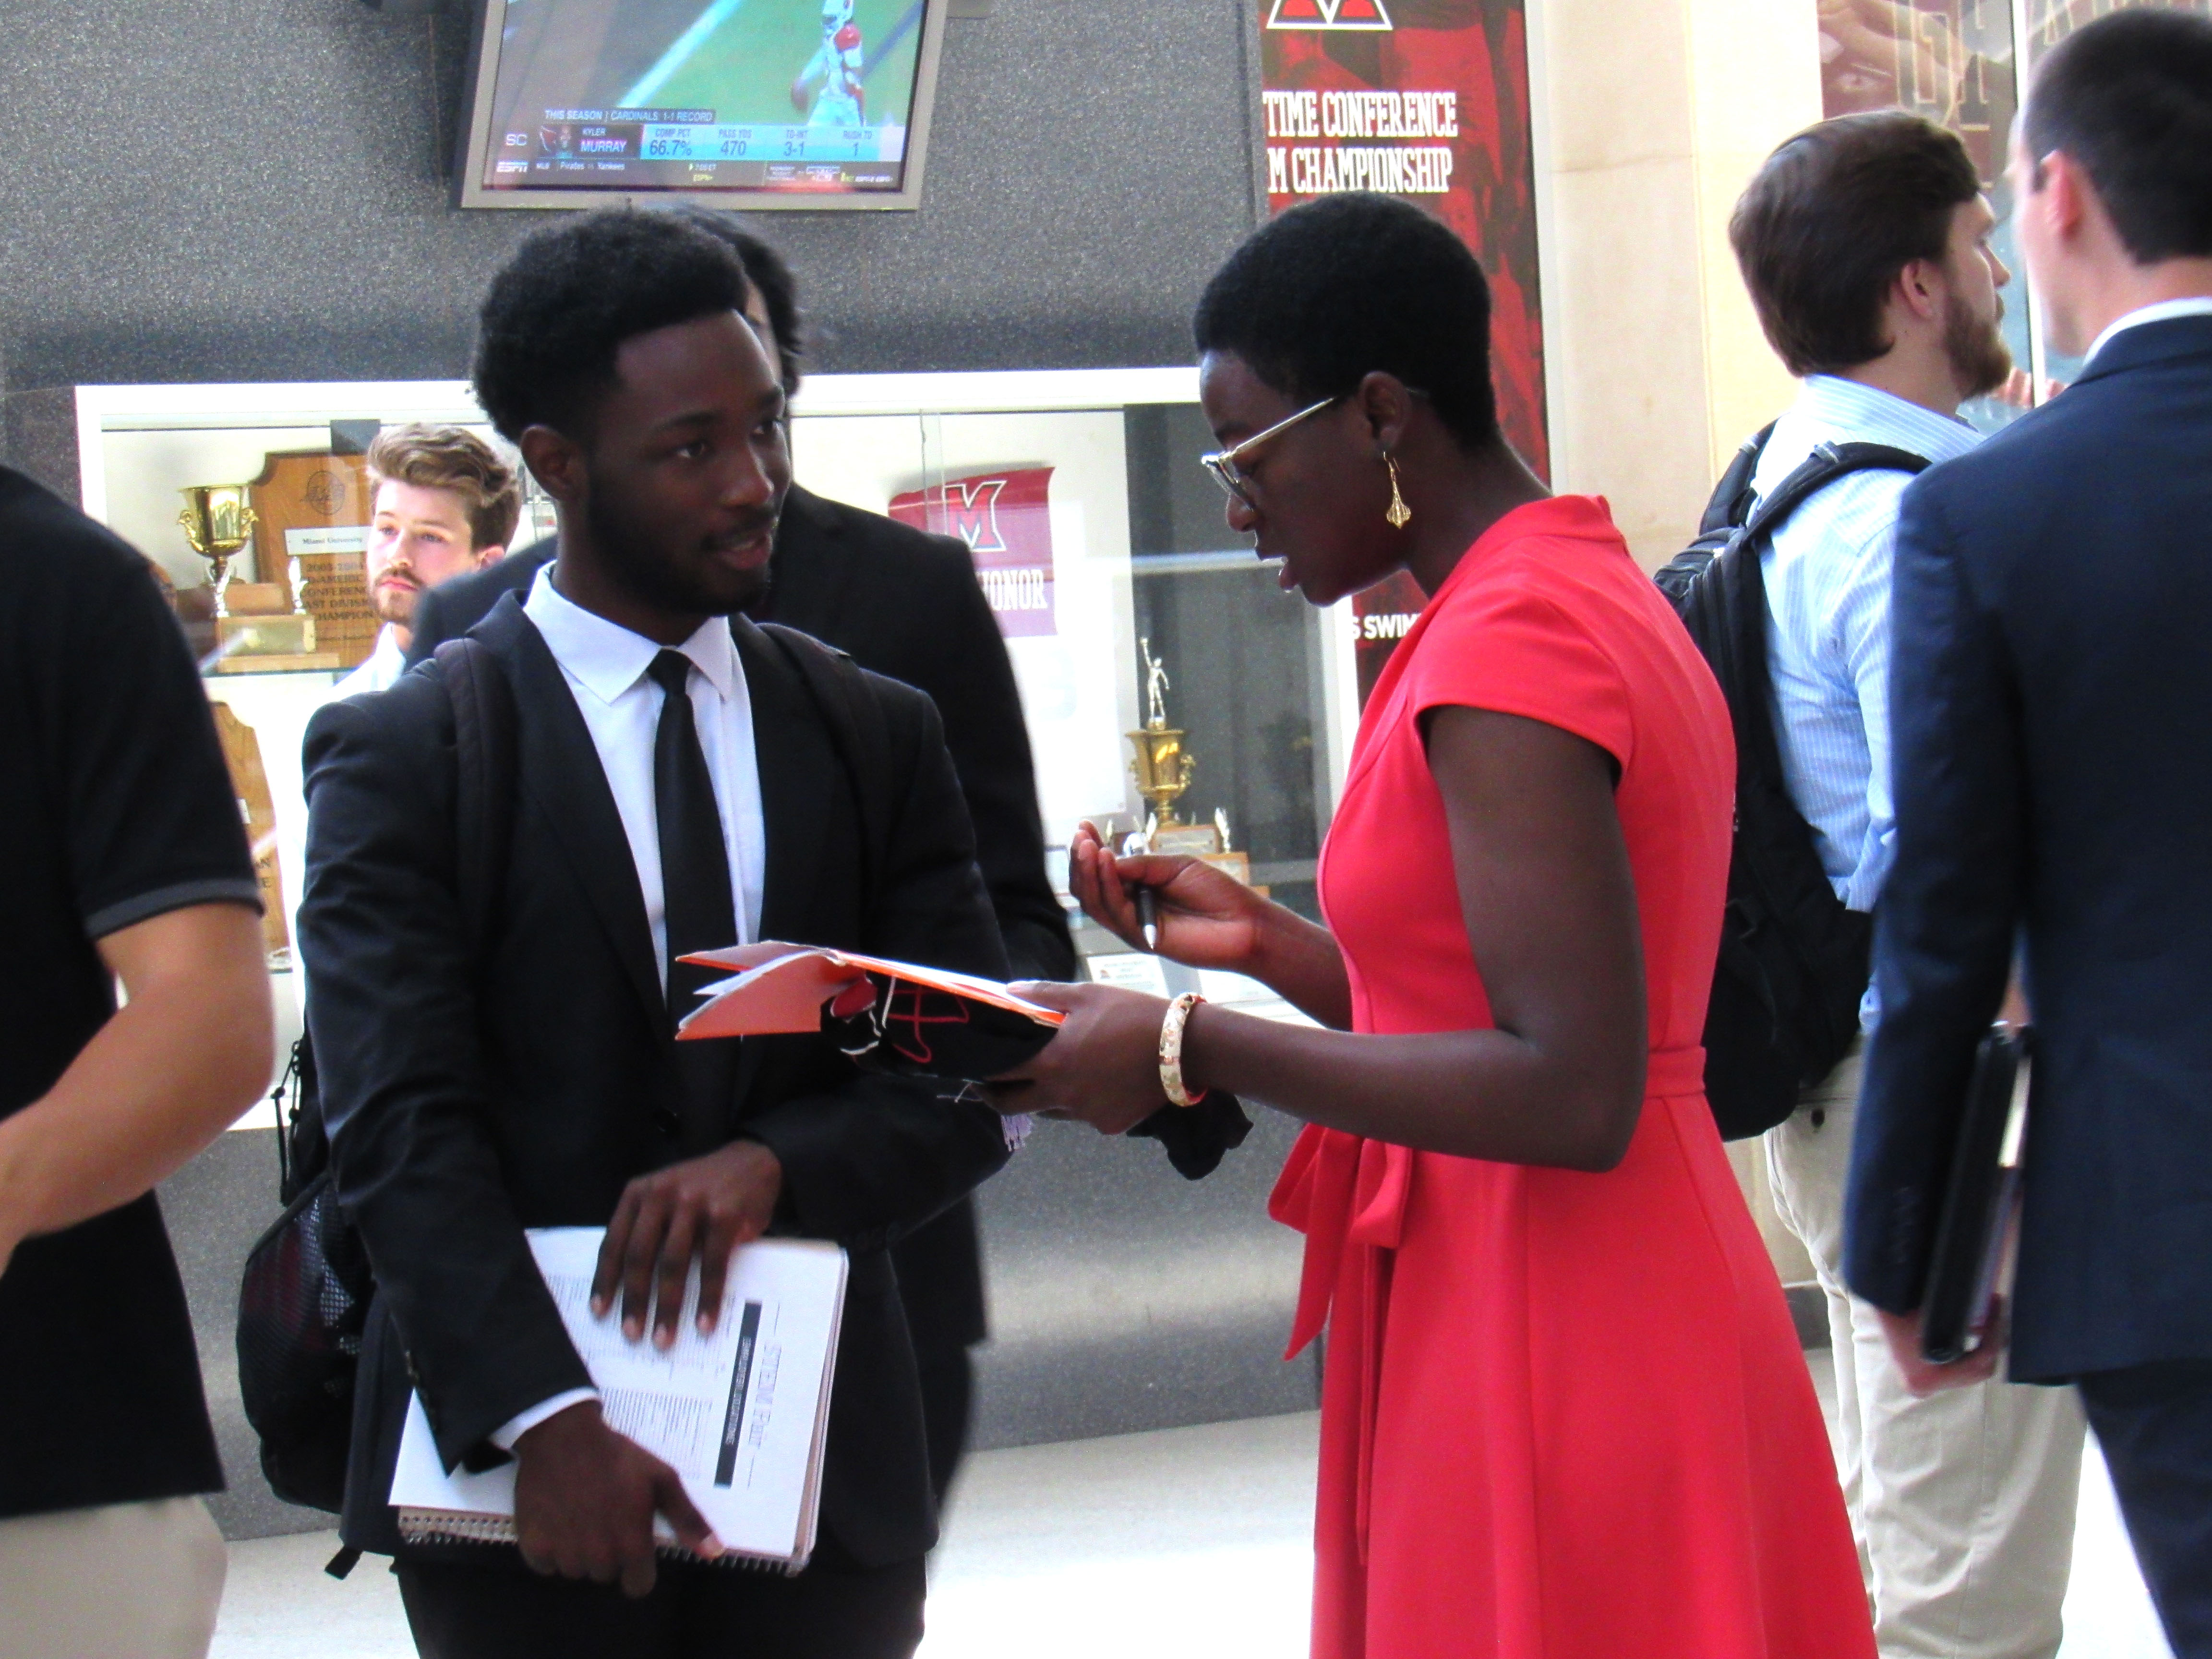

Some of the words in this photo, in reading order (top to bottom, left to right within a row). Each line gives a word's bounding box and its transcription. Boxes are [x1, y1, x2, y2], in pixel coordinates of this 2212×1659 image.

[545, 109, 565, 120] THIS
[567, 109, 603, 120] SEASON
[611, 110, 658, 120] CARDINALS
[677, 111, 714, 121] RECORD
[1262, 92, 1319, 137] TIME
[1322, 92, 1458, 137] CONFERENCE
[582, 128, 606, 136] KYLER
[678, 128, 691, 137] PCT
[719, 129, 736, 138] PASS
[506, 133, 527, 146] SC
[580, 139, 627, 152] MURRAY
[649, 140, 692, 156] 66.7%
[721, 140, 747, 156] 470
[783, 141, 804, 156] 3-1
[853, 143, 859, 156] 1
[497, 161, 529, 172] ESPN
[1292, 147, 1453, 193] CHAMPIONSHIP
[943, 480, 1007, 552] M
